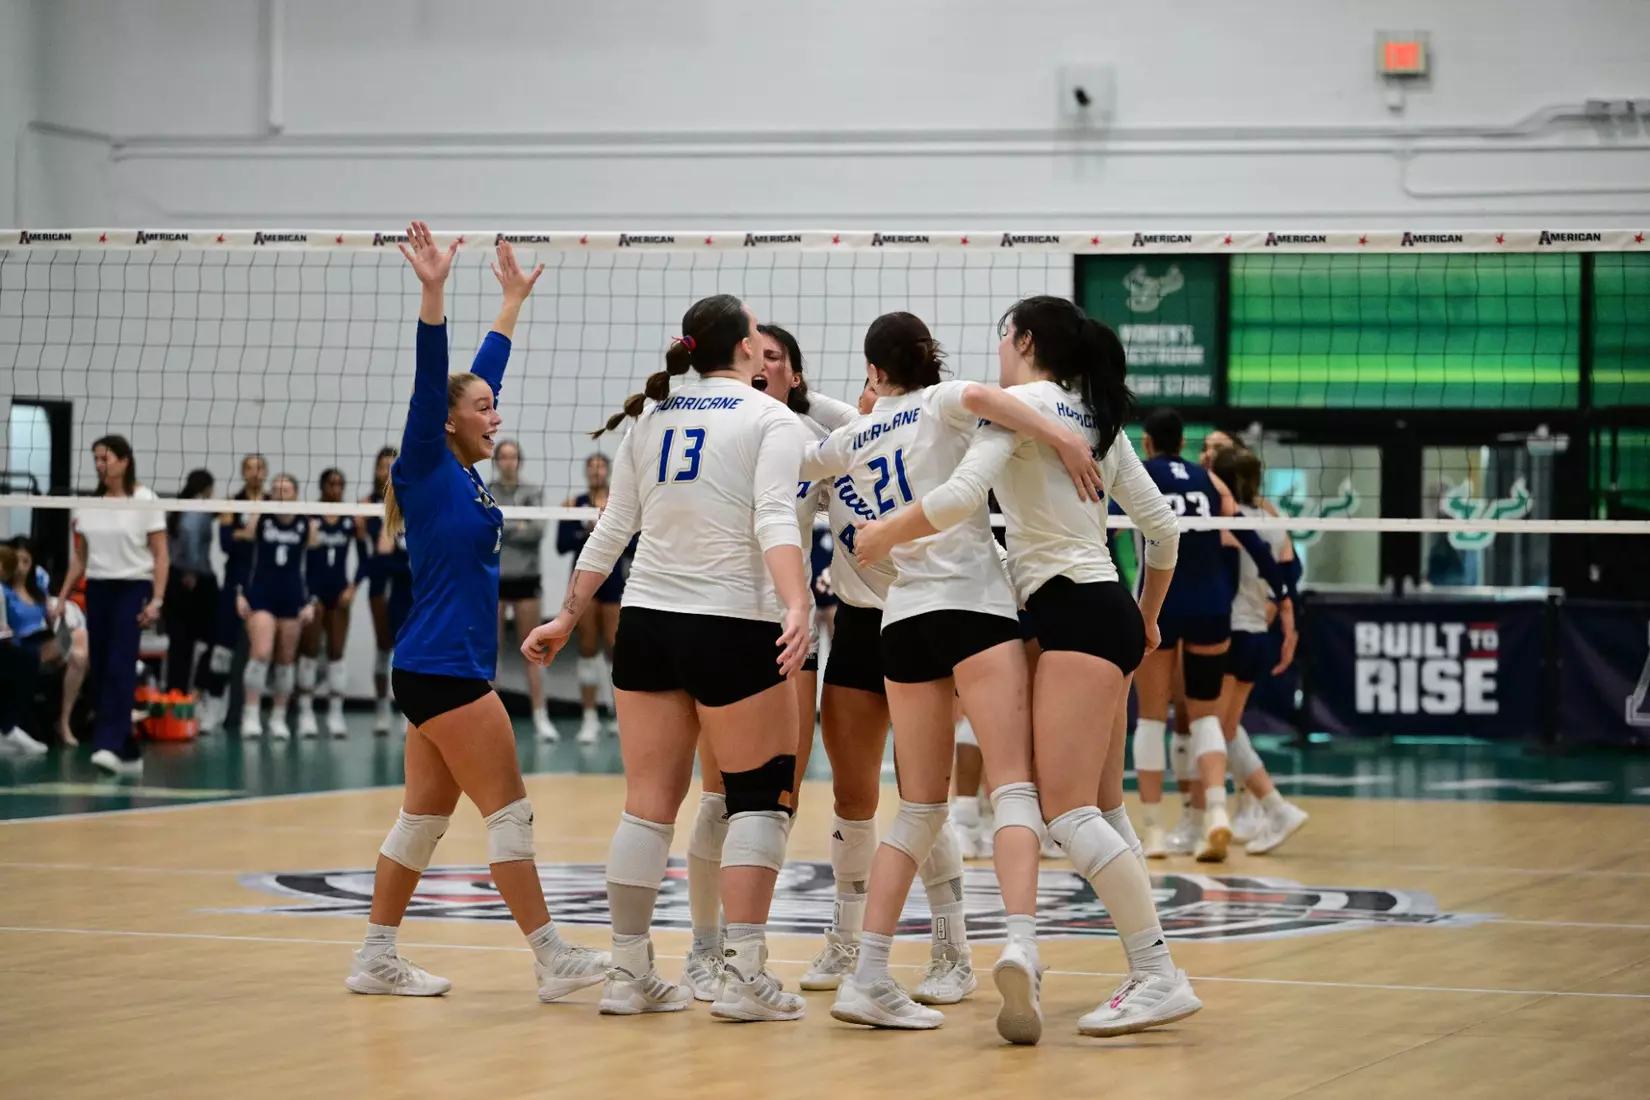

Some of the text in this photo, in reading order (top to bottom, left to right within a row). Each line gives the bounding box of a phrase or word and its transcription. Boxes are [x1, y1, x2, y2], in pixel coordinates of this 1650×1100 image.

[19, 230, 72, 245] AMERICAN
[135, 230, 189, 245] AMERICAN
[253, 231, 307, 246] AMERICAN
[373, 232, 409, 246] AMERI
[619, 232, 675, 247] AMERICAN
[744, 232, 802, 247] AMERICAN
[872, 232, 930, 247] AMERICAN
[1000, 232, 1060, 247] AMERICAN
[1132, 232, 1192, 247] AMERICAN
[1265, 232, 1327, 247] AMERICAN
[1401, 232, 1463, 247] AMERICAN
[1538, 230, 1602, 246] AMERICAN
[657, 427, 707, 484] 13
[865, 446, 915, 517] 21
[1354, 621, 1499, 659] BUILT TO
[1354, 658, 1499, 714] RISE
